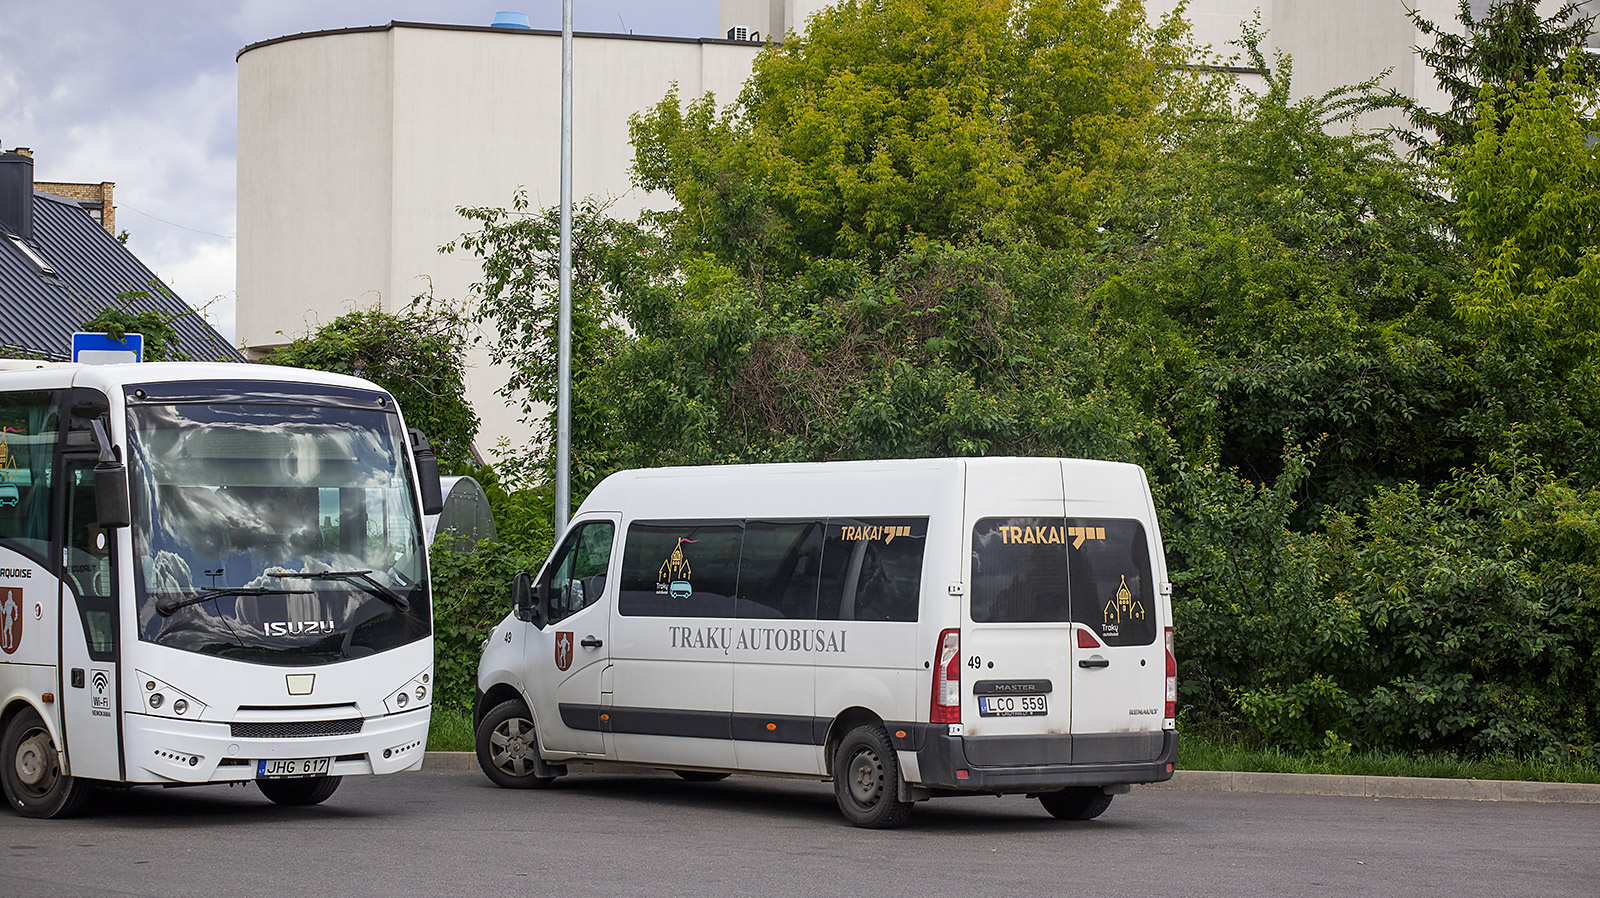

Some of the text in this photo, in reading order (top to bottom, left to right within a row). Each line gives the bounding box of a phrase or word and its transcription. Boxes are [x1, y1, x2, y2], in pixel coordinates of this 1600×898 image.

[841, 525, 883, 541] TRAKAI
[999, 526, 1065, 544] TRAKAI
[263, 620, 335, 637] ISUZU
[504, 631, 513, 644] 49
[669, 626, 848, 656] TRAKŲ AUTOBUSAI
[967, 655, 982, 669] 49
[987, 697, 1045, 711] LCO 559
[266, 759, 327, 774] JHG 617
